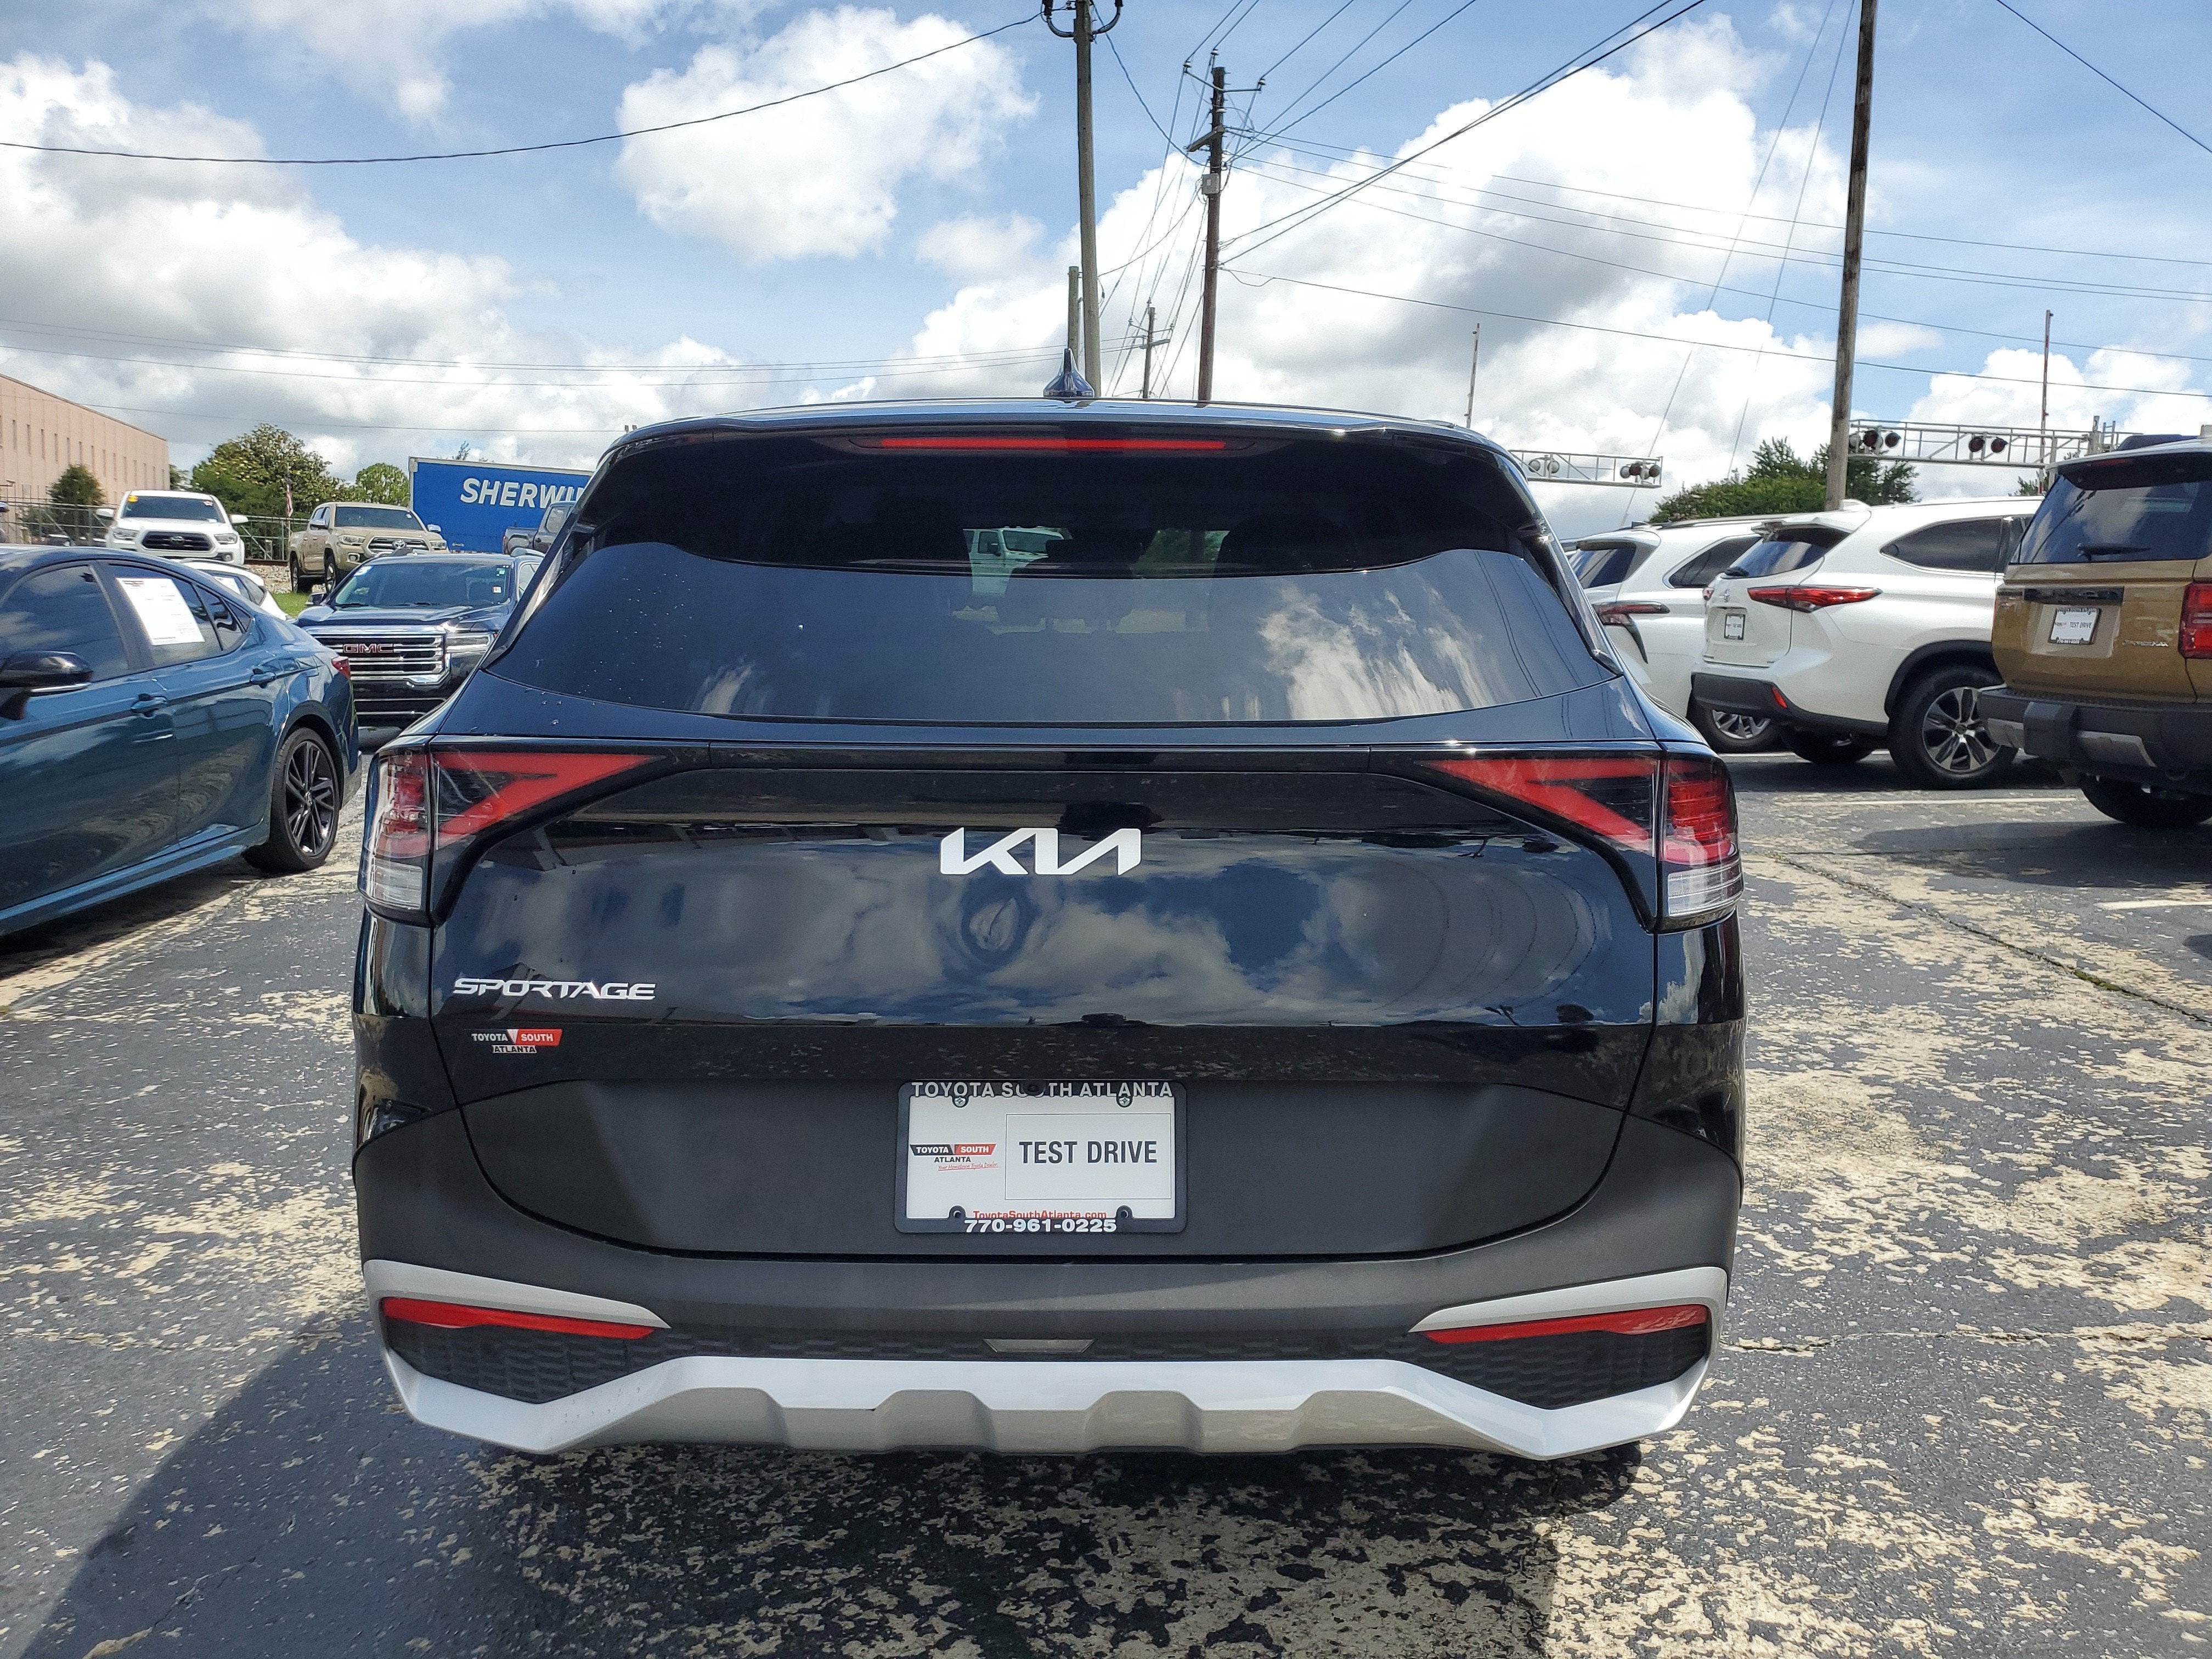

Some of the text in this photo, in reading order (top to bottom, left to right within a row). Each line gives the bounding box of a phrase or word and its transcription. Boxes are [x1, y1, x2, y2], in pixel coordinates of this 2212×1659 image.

[343, 643, 394, 653] GMC
[940, 827, 1141, 876] KIA
[453, 978, 656, 1000] SPORTAGE
[471, 1033, 554, 1042] TOYOTA SOUTH
[911, 1082, 1172, 1097] TOYOTA STH ATLANTA
[1019, 1141, 1158, 1164] TEST DRIVE
[973, 1210, 1107, 1218] ToyotaSouthAtlanta.com
[964, 1218, 1118, 1233] 770-961-0225
